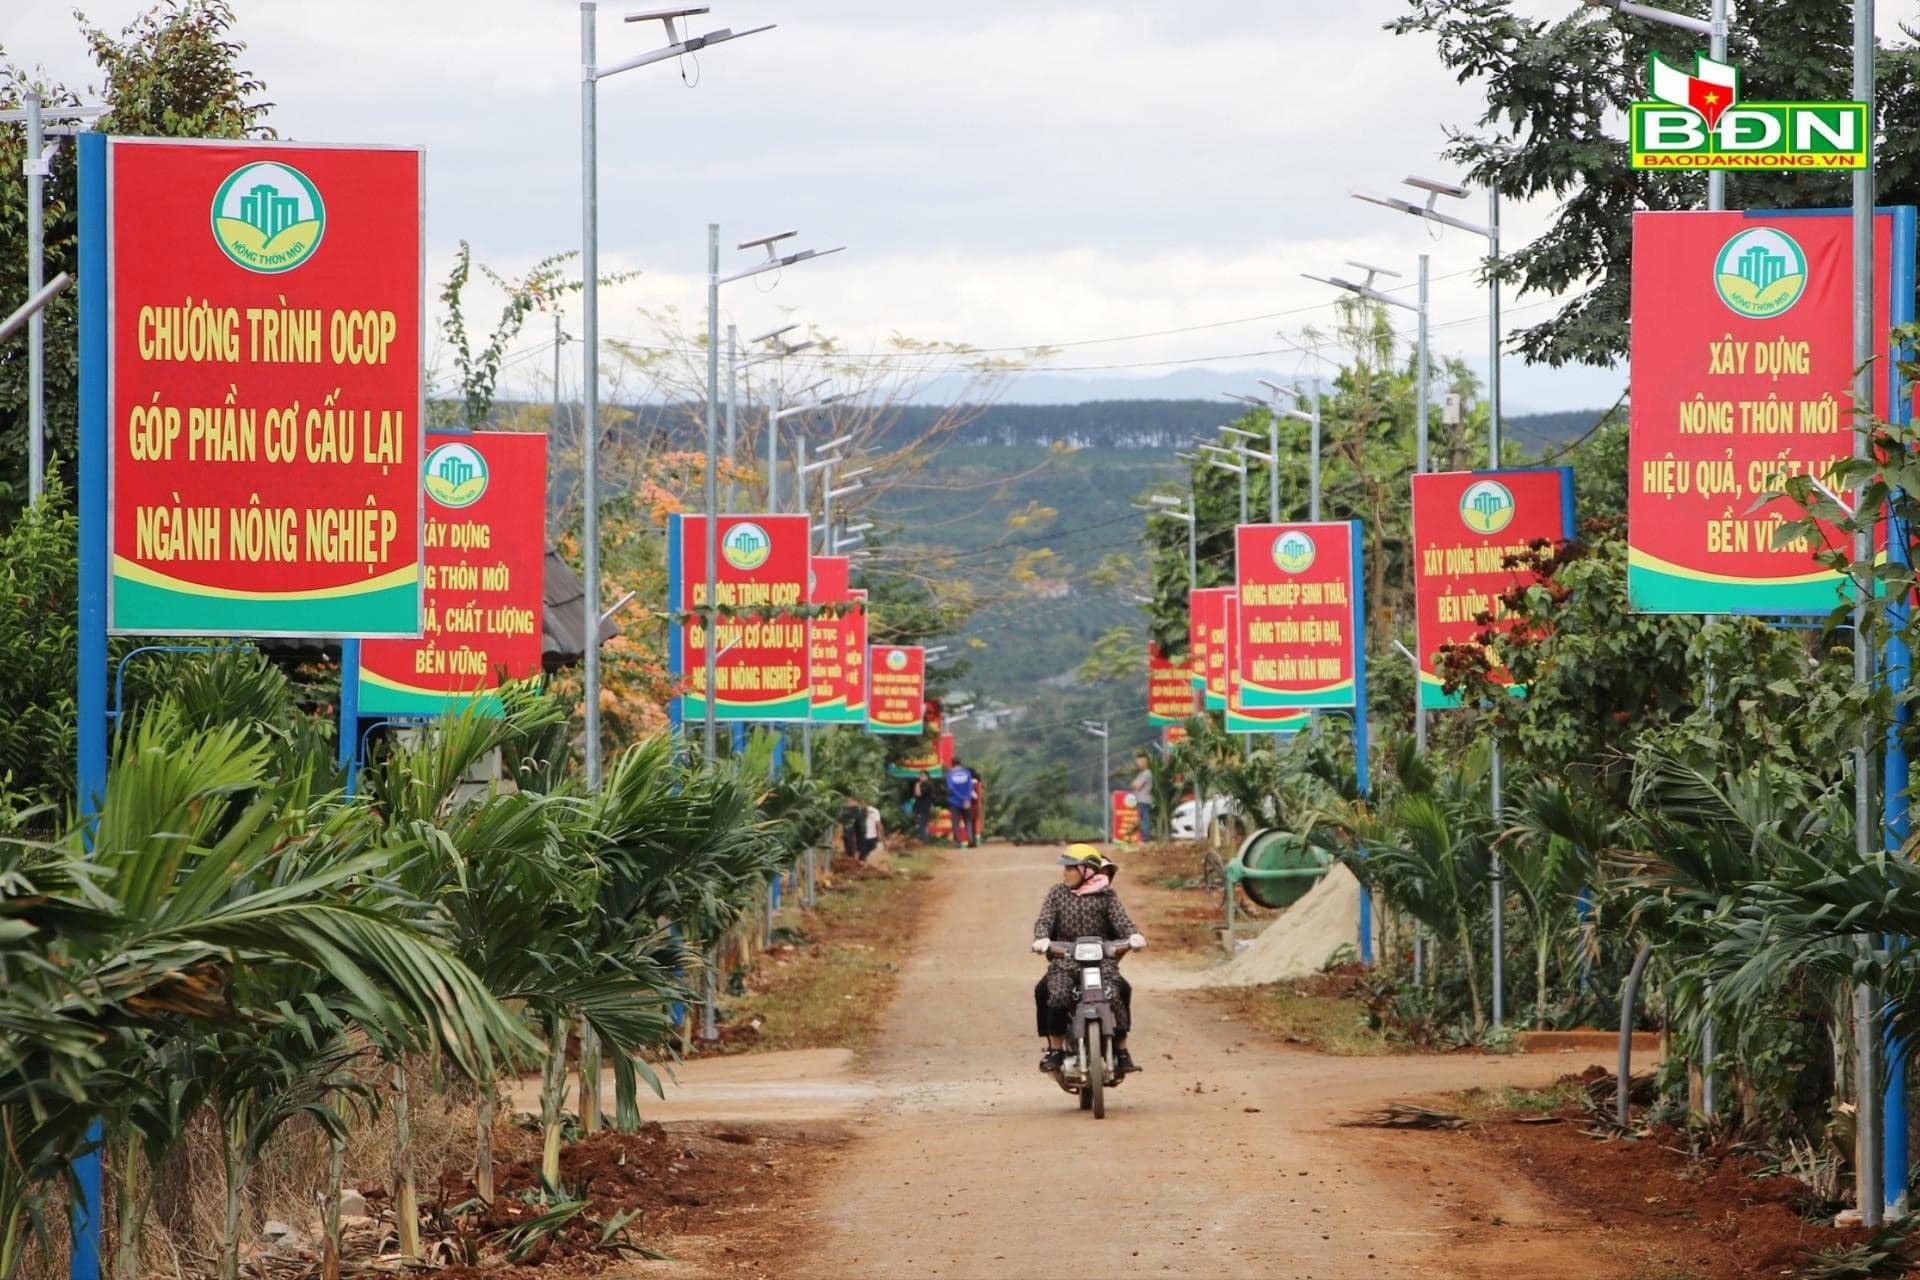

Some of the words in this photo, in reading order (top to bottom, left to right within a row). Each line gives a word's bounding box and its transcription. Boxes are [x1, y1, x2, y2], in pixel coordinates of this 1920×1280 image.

[138, 296, 240, 363] CHƯƠNG
[247, 295, 322, 364] TRÌNH
[330, 308, 397, 365] OCOP
[1708, 333, 1747, 375] XÂY
[1754, 335, 1810, 381] DỰNG
[129, 391, 182, 461] GÓP
[188, 384, 256, 463] PHẦN
[264, 401, 300, 463] CƠ
[305, 388, 355, 464] CẤU
[363, 410, 403, 475] LẠI
[1679, 393, 1734, 434] NÔNG
[1739, 393, 1794, 434] THÔN
[1800, 396, 1838, 434] MỚI
[1643, 452, 1690, 500] HIỆU
[1696, 448, 1742, 499] QUẢ,
[136, 492, 221, 561] NGÀNH
[230, 493, 297, 563] NÔNG
[305, 495, 397, 574] NGHIỆP
[451, 520, 490, 554] DỰNG
[1707, 505, 1749, 553] BỀN
[440, 560, 478, 590] THÔN
[482, 561, 510, 591] MỚI
[1423, 541, 1444, 576] XÂY
[1446, 543, 1475, 580] DỰNG
[1476, 540, 1504, 574] NÔNG
[772, 582, 801, 607] OCOP
[1242, 579, 1267, 606] NÔNG
[1267, 577, 1300, 610] NGHIỆP
[1300, 583, 1322, 605] SINH
[445, 600, 484, 632] CHẤT
[487, 606, 534, 640] LƯỢNG
[745, 621, 761, 649] CƠ
[785, 624, 804, 653] LẠI
[1249, 616, 1274, 643] NÔNG
[1274, 615, 1300, 643] THÔN
[1300, 615, 1322, 647] HIỆN
[415, 640, 446, 673] BỀN
[449, 645, 488, 675] VỮNG
[731, 660, 760, 690] NÔNG
[762, 658, 801, 694] NGHIỆP
[1252, 653, 1277, 681] NÔNG
[1277, 653, 1297, 681] DÂN
[1317, 658, 1341, 680] MINH
